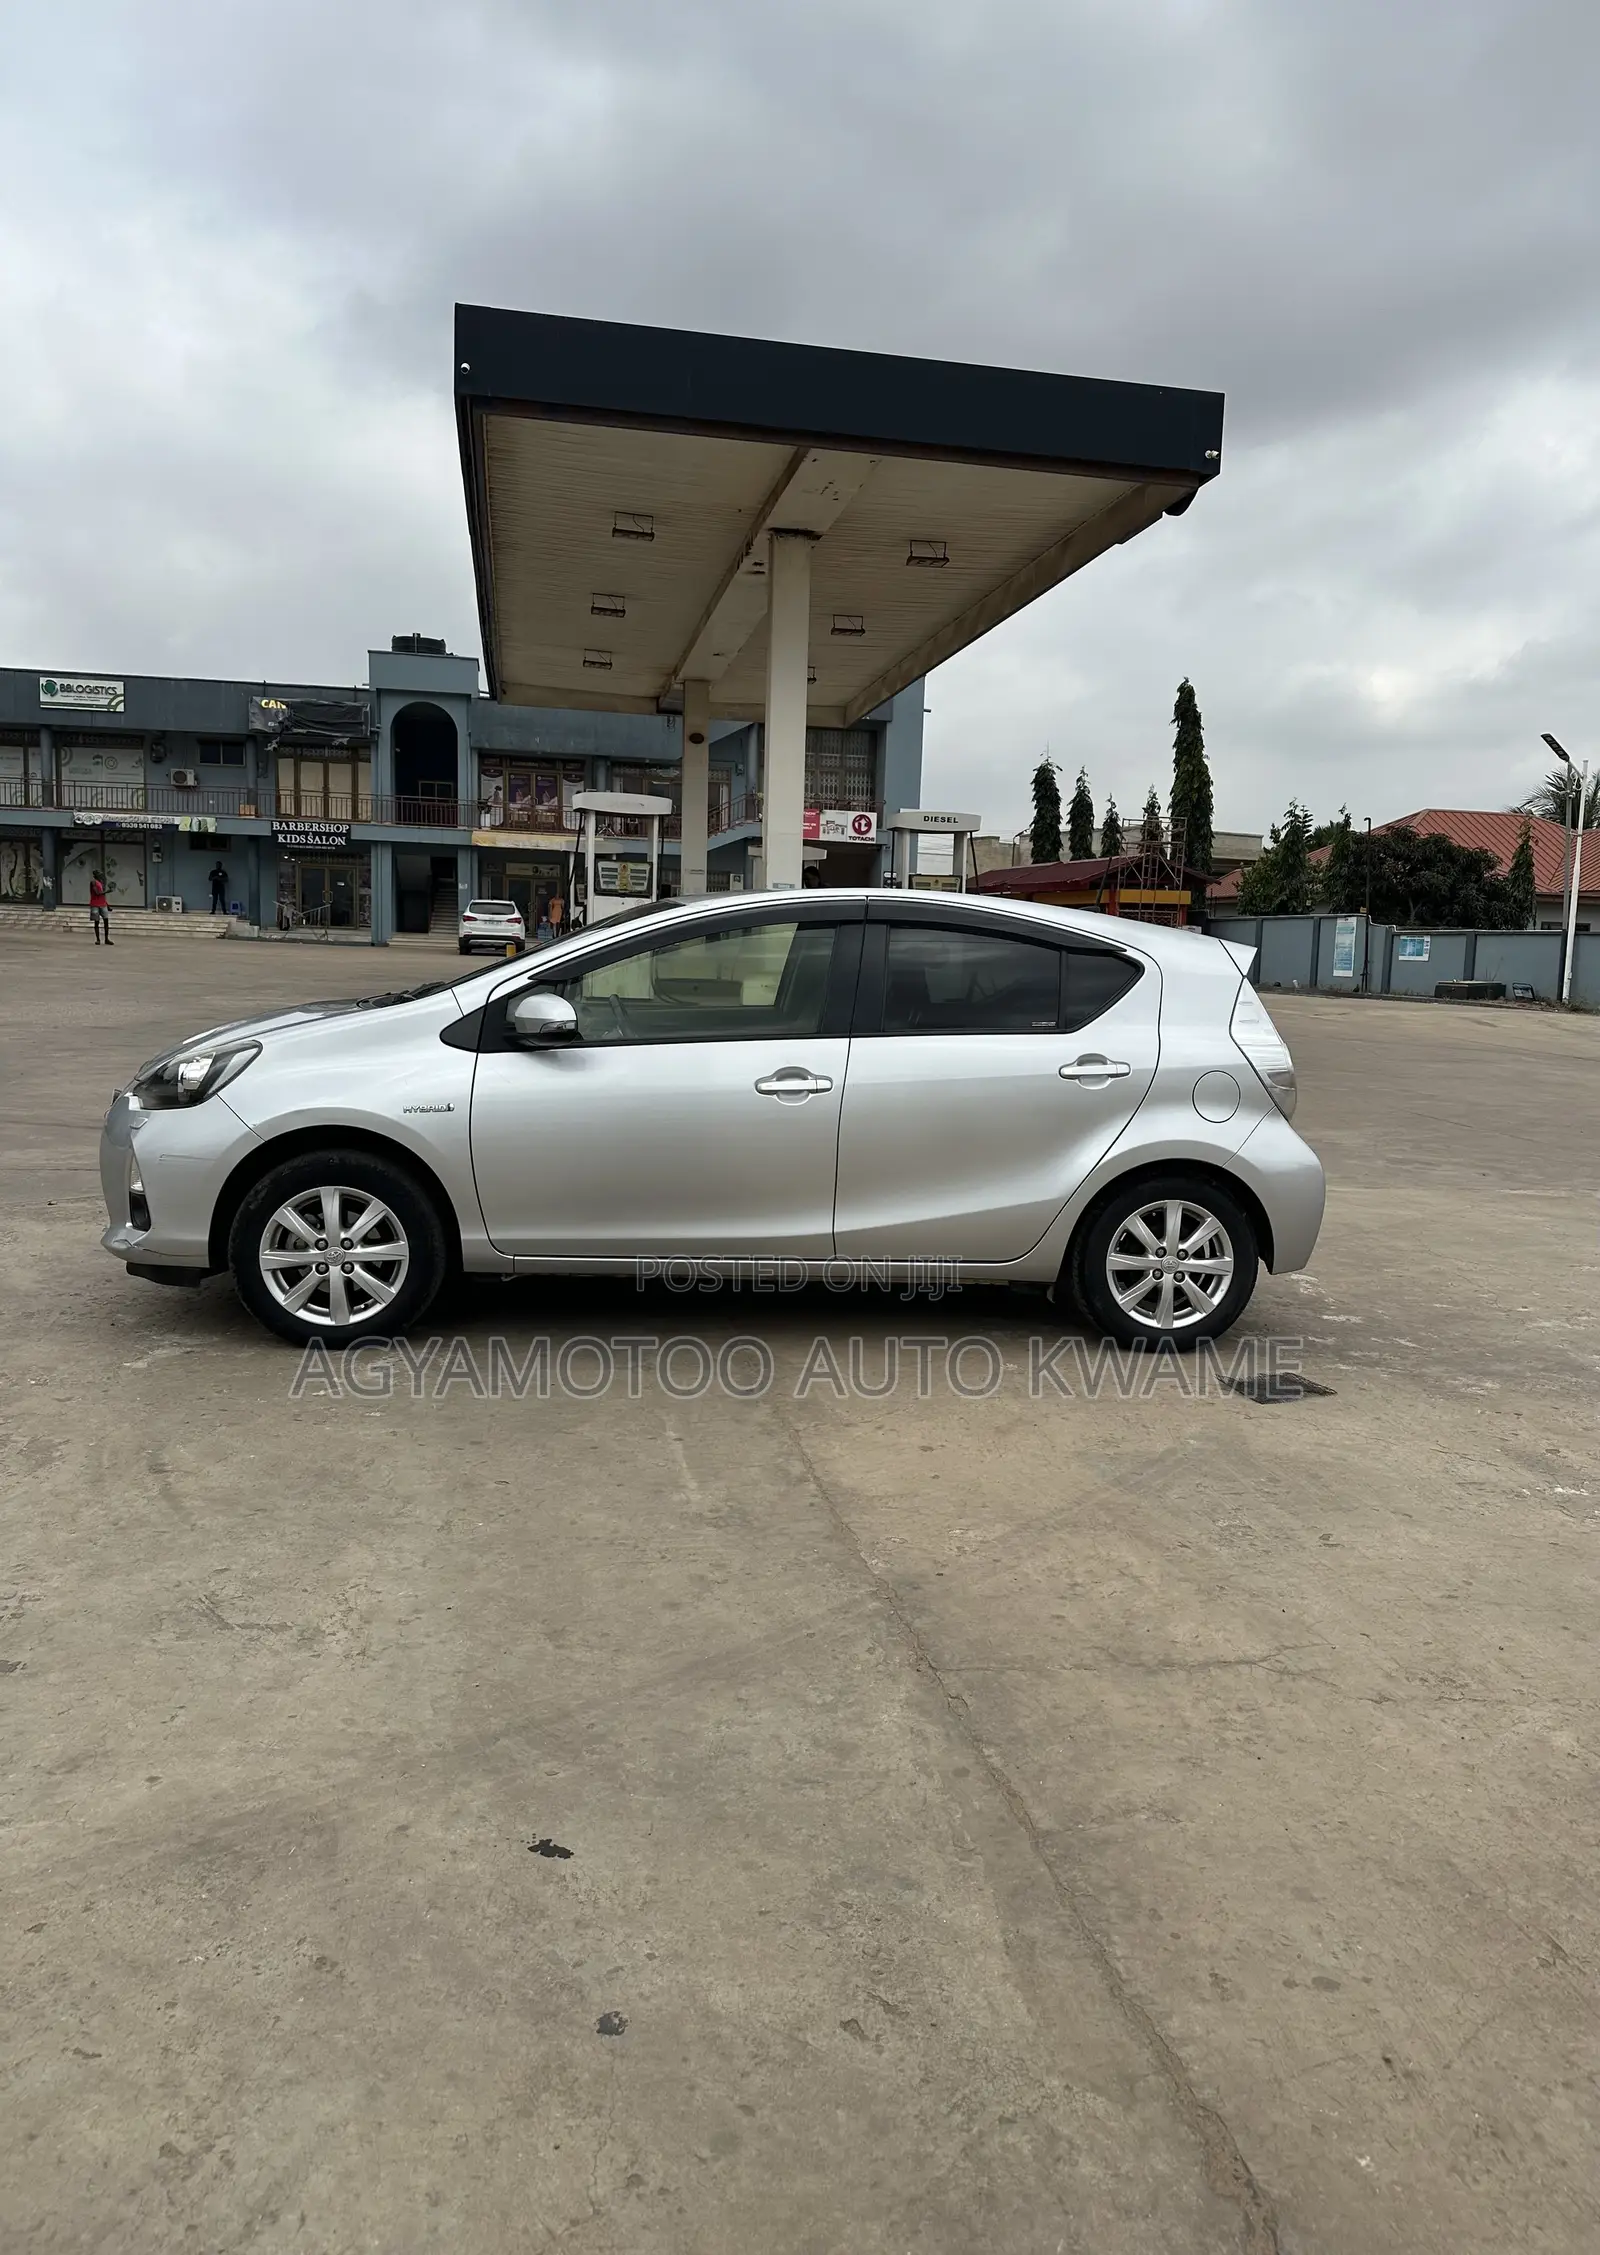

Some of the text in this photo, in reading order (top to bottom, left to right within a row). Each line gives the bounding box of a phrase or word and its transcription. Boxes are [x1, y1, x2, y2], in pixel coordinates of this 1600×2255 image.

[923, 815, 959, 824] DIESEL
[272, 821, 349, 833] BARBERSHOP
[277, 833, 347, 845] KIDS SALON
[403, 1104, 447, 1114] HYBRID
